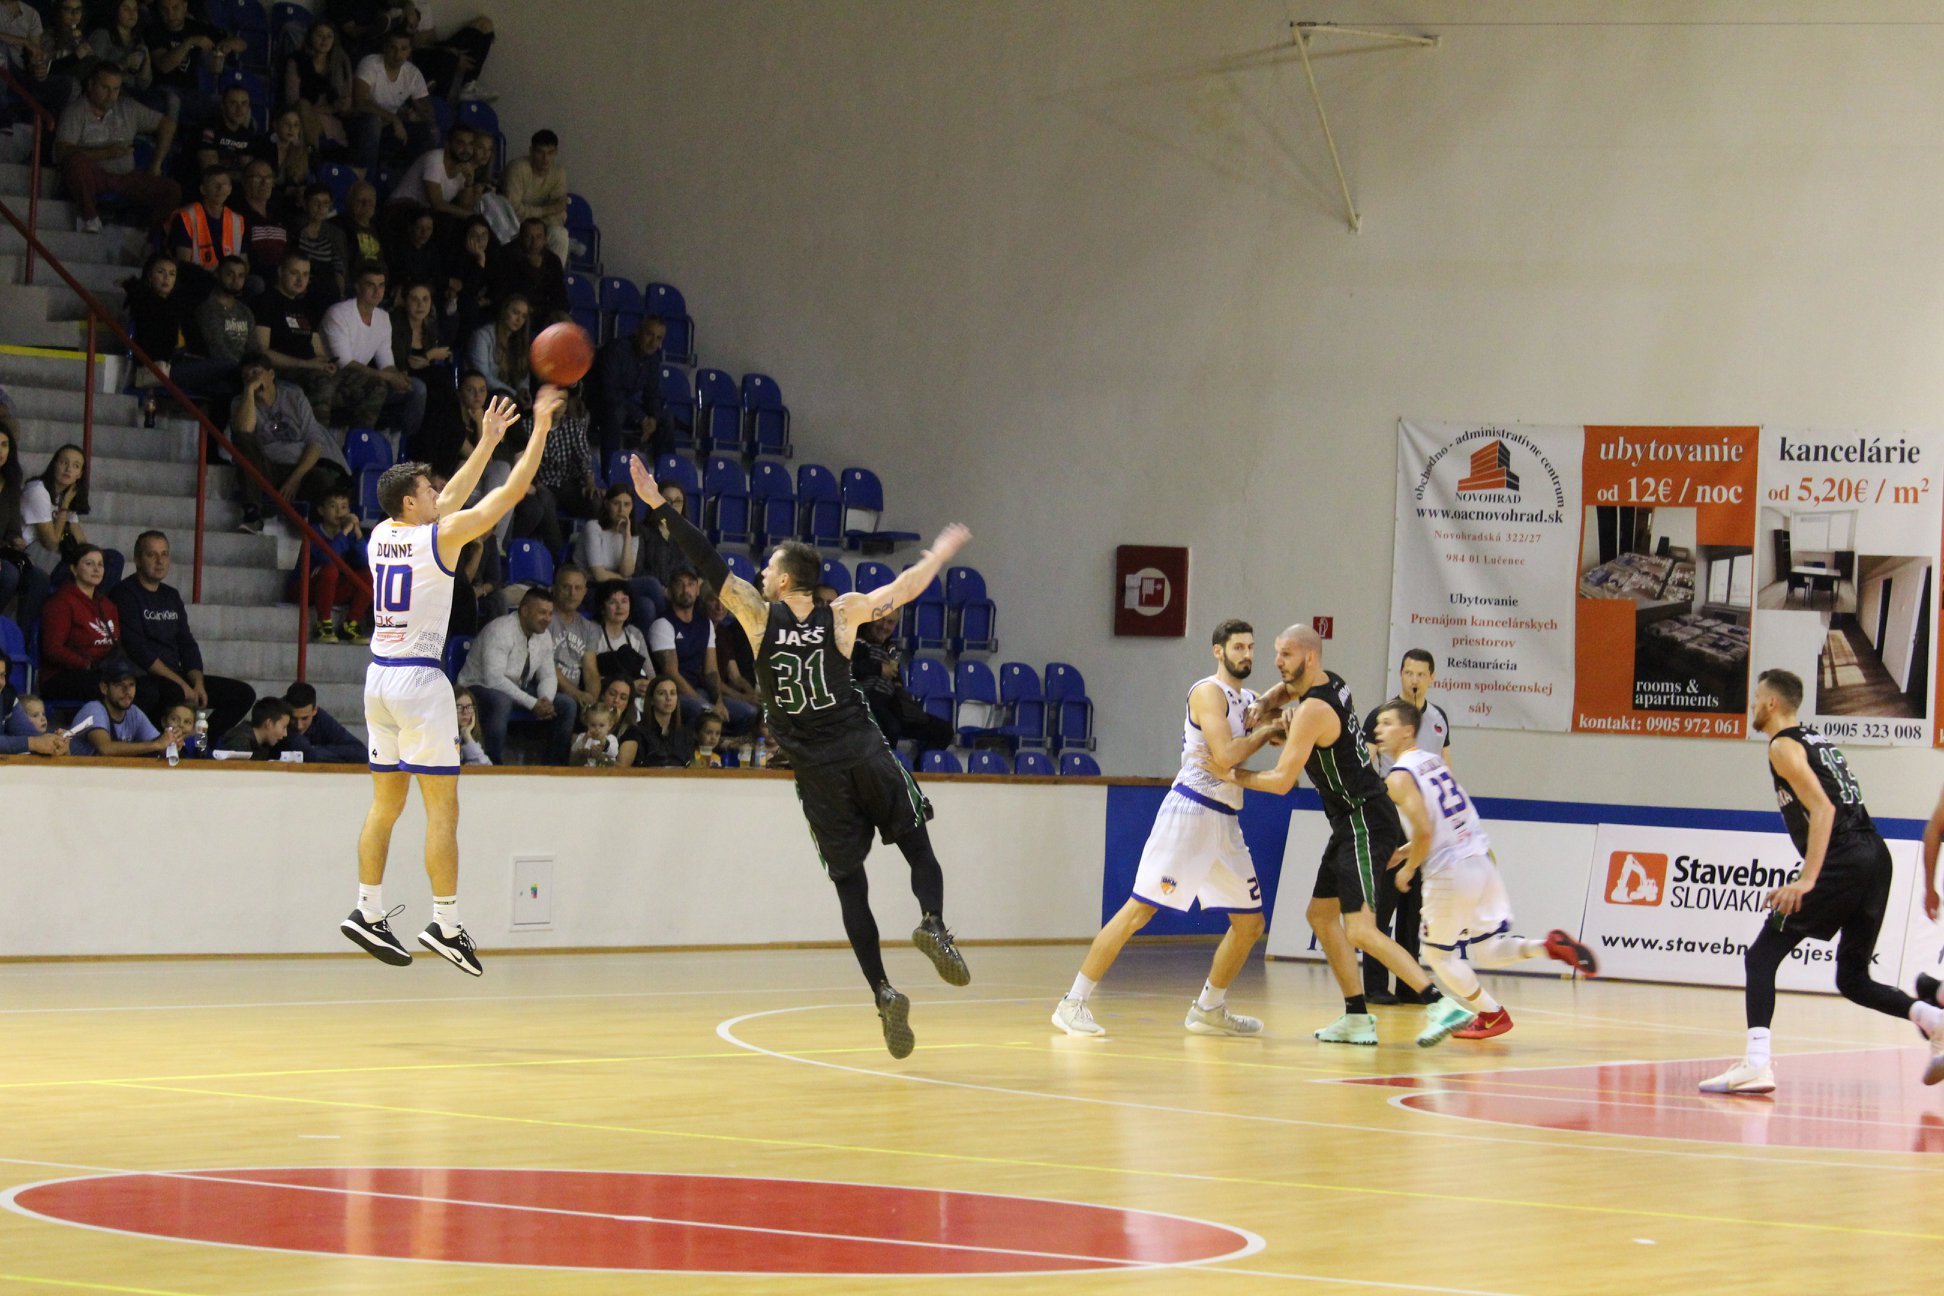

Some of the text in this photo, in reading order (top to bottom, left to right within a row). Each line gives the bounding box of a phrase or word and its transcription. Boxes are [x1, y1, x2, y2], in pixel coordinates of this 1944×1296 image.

[1600, 436, 1743, 467] ubytovanie
[1779, 436, 1921, 464] kancelárie
[1415, 446, 1449, 501] obchodno
[1455, 426, 1543, 458] administratívne
[1540, 457, 1565, 508] centrum
[1455, 492, 1521, 504] NOVOHRAD
[1597, 484, 1618, 502] od
[1627, 476, 1673, 503] 12€
[1695, 484, 1743, 504] noc
[1768, 484, 1790, 501] od
[1797, 476, 1869, 507] 5,20€
[1416, 508, 1564, 524] www.oacnovohrad.sk
[1434, 530, 1541, 543] Novohradská 322/27
[376, 542, 413, 559] DUNNE
[1446, 553, 1526, 566] 984 01 Lučenec
[375, 563, 413, 612] 10
[1450, 593, 1519, 607] Ubytovanie
[1411, 613, 1558, 633] Prenájom kancelárskych
[1452, 635, 1516, 648] priestorov
[1447, 657, 1518, 671] Reštaurácia
[769, 648, 837, 714] 31
[1430, 679, 1553, 696] nájom spoločenskej
[1636, 678, 1699, 694] rooms &
[1468, 702, 1493, 714] sály
[1635, 692, 1719, 708] apartments
[1578, 713, 1740, 735] kontakt: 0905 972 061
[1823, 722, 1858, 738] 0905
[1862, 723, 1890, 738] 323
[1894, 725, 1922, 740] 008
[1429, 770, 1468, 819] 23
[1672, 854, 1803, 888] Stavebné
